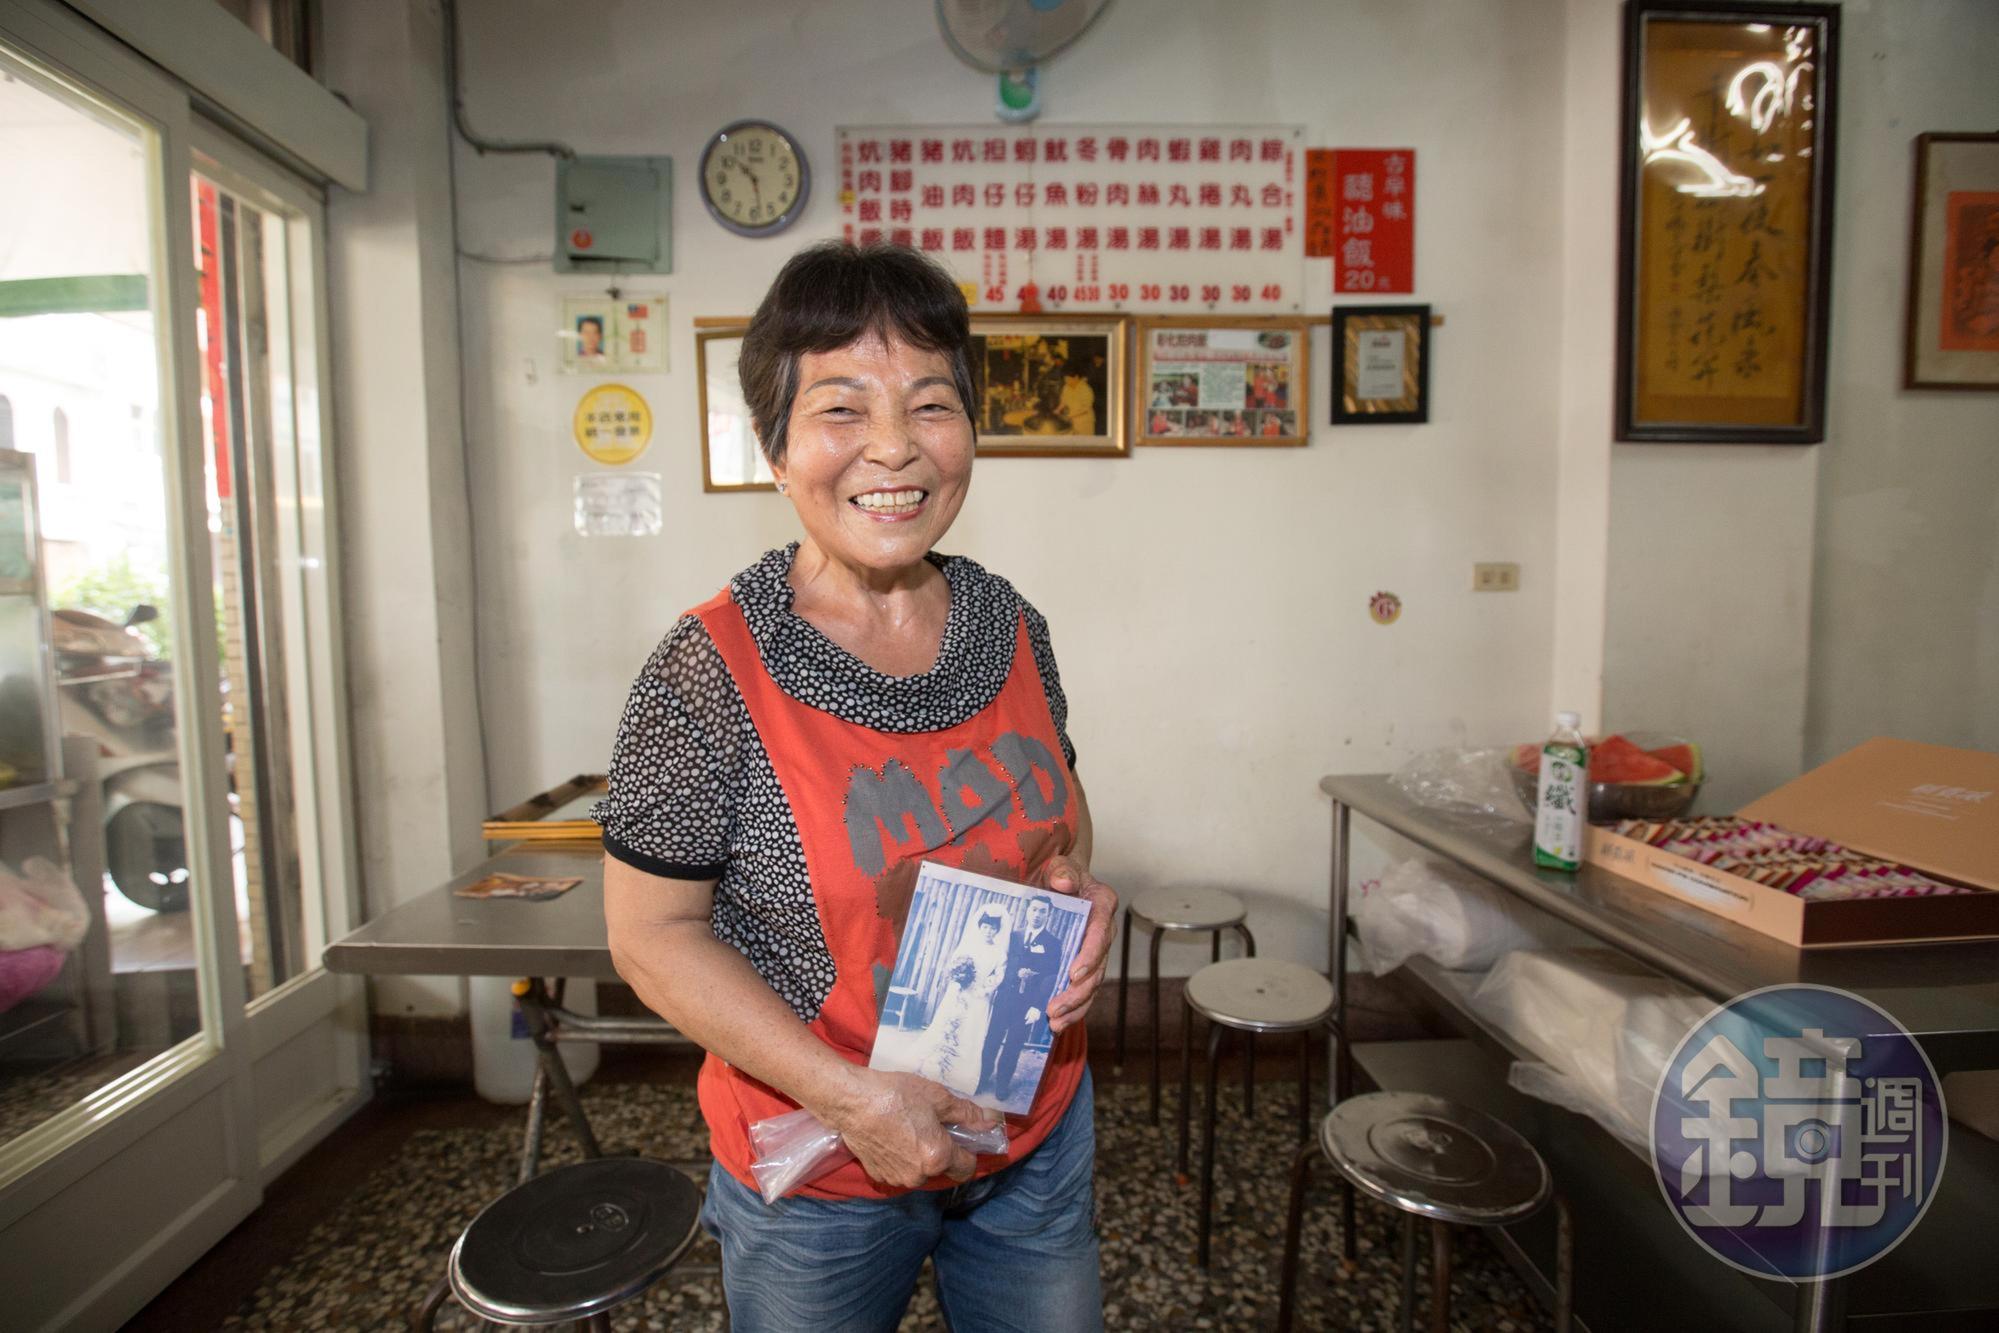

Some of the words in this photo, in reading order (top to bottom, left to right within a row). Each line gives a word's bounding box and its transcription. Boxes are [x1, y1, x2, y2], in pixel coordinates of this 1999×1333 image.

[1344, 269, 1375, 290] 20
[1047, 285, 1067, 302] 40
[1108, 284, 1128, 301] 30
[1140, 284, 1160, 301] 30
[1169, 284, 1189, 301] 30
[1202, 284, 1221, 301] 30
[1232, 284, 1251, 301] 30
[1261, 284, 1281, 301] 40
[842, 729, 1069, 878] MAD
